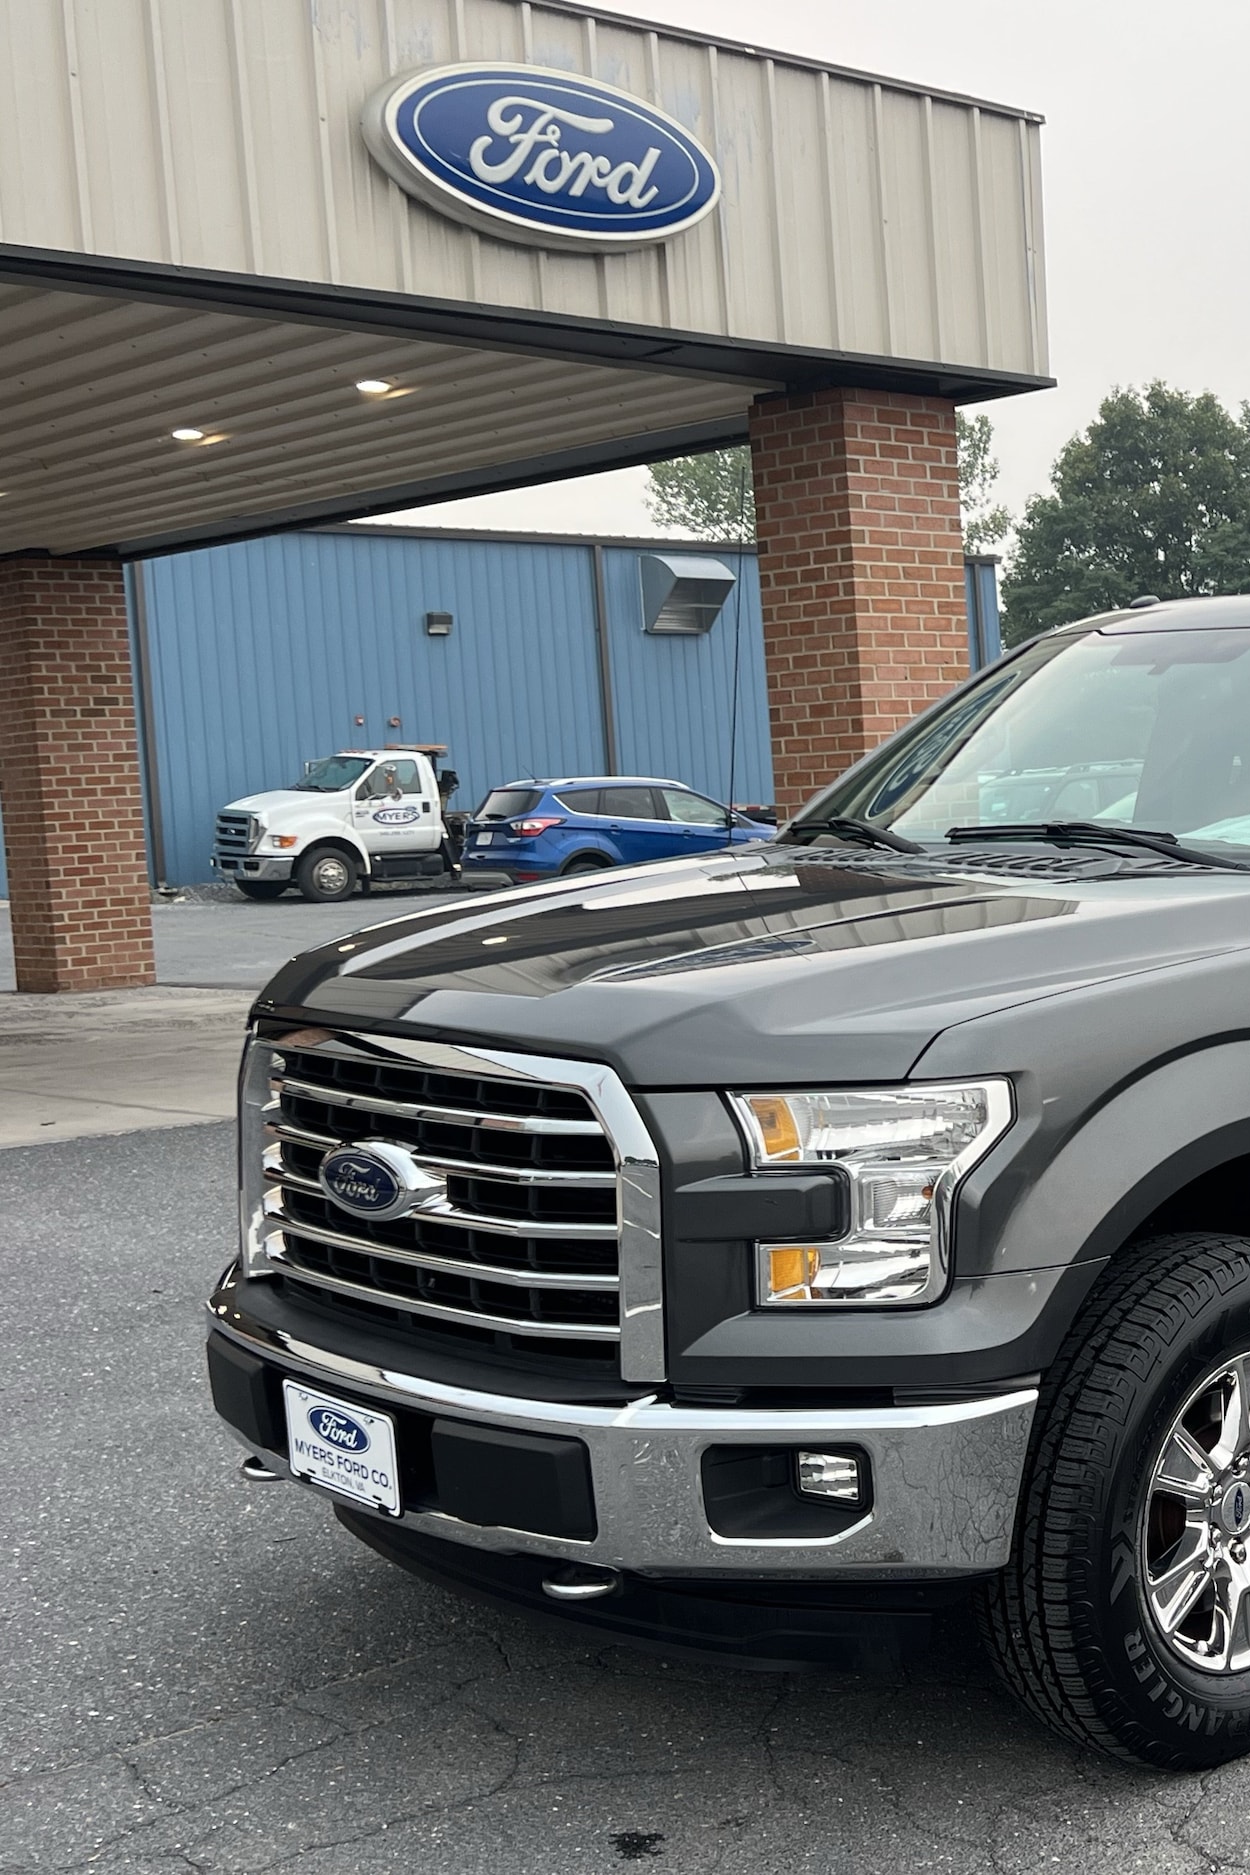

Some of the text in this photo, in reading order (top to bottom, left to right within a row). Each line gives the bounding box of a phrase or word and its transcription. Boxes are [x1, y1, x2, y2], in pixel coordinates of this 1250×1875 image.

[469, 95, 662, 209] Ford
[374, 811, 419, 821] MYERS
[333, 1161, 380, 1202] Ford
[319, 1411, 358, 1449] Ford
[295, 1437, 392, 1490] MYERS FORD CO.
